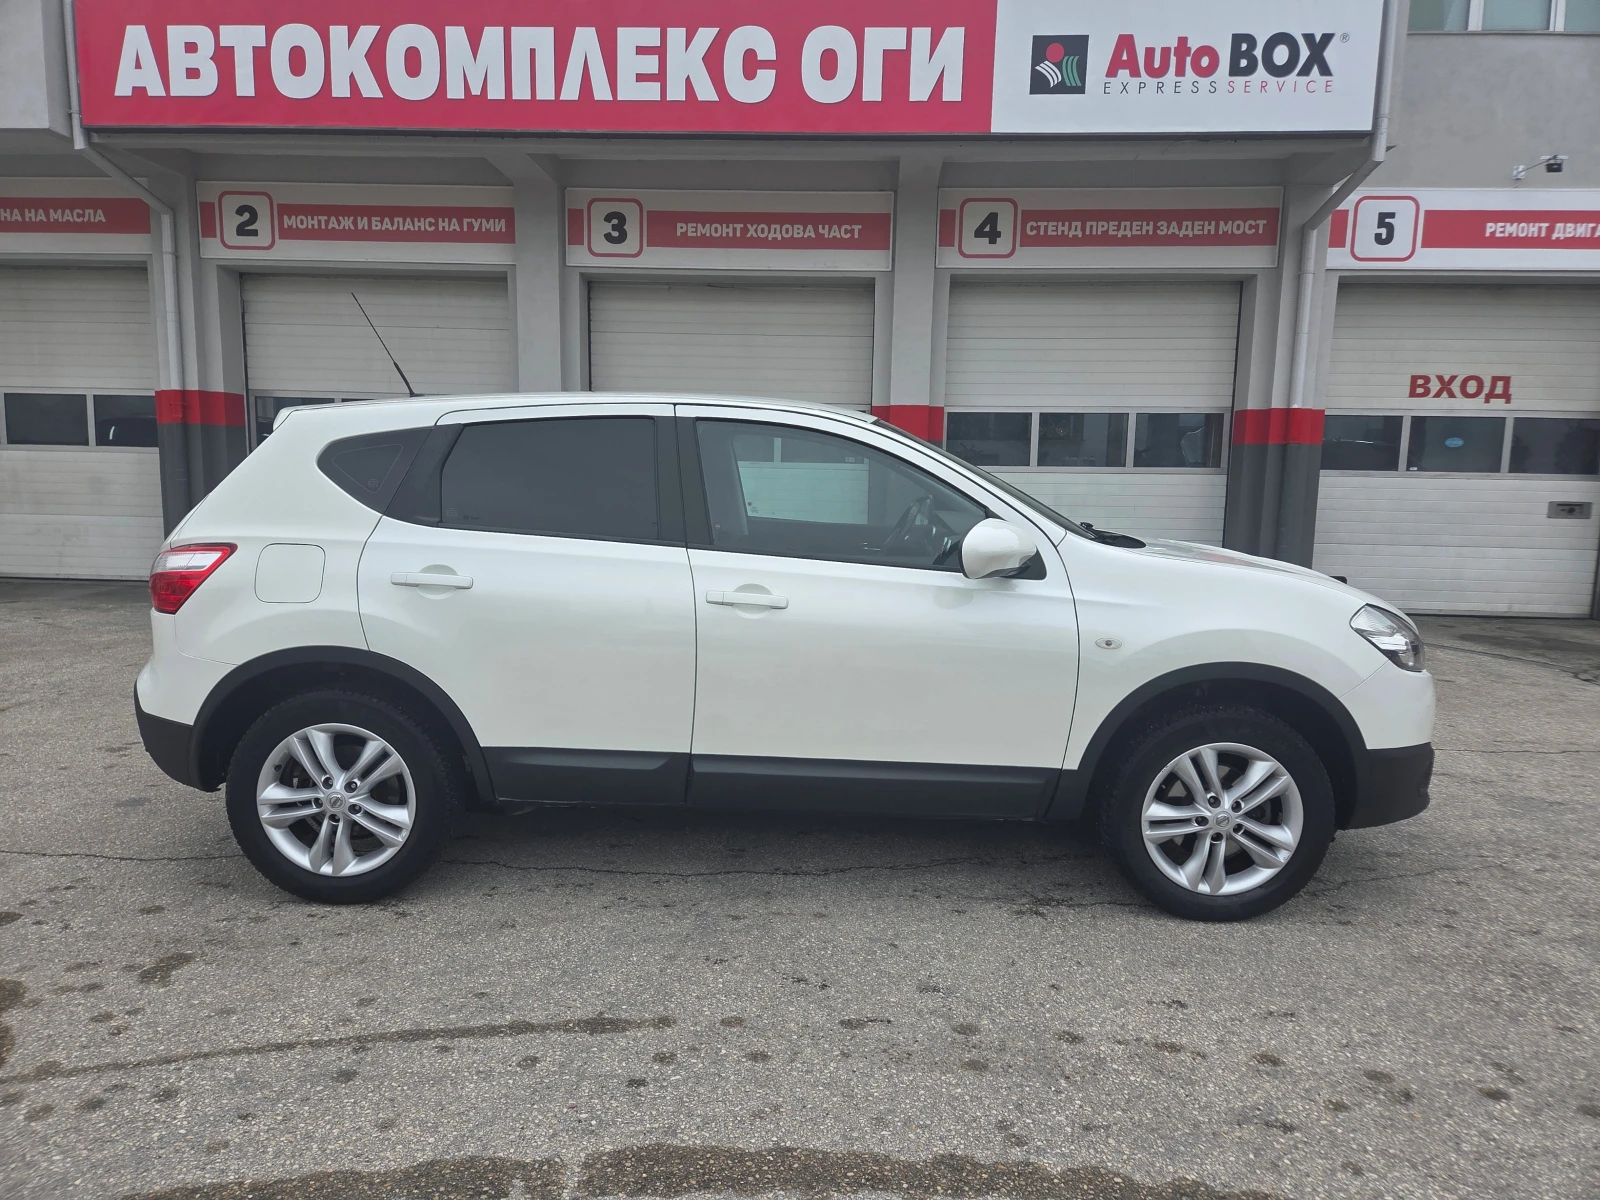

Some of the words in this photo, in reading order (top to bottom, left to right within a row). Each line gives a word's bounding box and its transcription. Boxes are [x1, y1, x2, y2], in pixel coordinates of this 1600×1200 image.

[114, 23, 778, 104] АВТОКОМПЛЕКС
[800, 24, 966, 104] ОГИ
[1104, 33, 1220, 79] Auto
[1228, 31, 1336, 79] BOX
[25, 208, 47, 222] НА
[49, 208, 107, 223] МАСЛА
[234, 204, 259, 238] 2
[283, 214, 355, 231] МОНТАЖ
[356, 215, 369, 231] И
[371, 216, 436, 232] БАЛАНС
[438, 217, 461, 232] НА
[463, 217, 506, 233] ГУМИ
[603, 211, 628, 245] 3
[676, 222, 744, 238] РЕМОНТ
[746, 223, 816, 241] ХОДОВА
[818, 224, 862, 239] ЧАСТ
[973, 211, 1002, 245] 4
[1026, 221, 1083, 238] СТЕНД
[1085, 221, 1154, 238] ПРЕДЕН
[1156, 221, 1216, 238] ЗАДЕН
[1218, 219, 1267, 234] МОСТ
[1374, 211, 1396, 246] 5
[1485, 222, 1550, 238] РЕМОНТ
[1408, 374, 1512, 405] ВХОД
